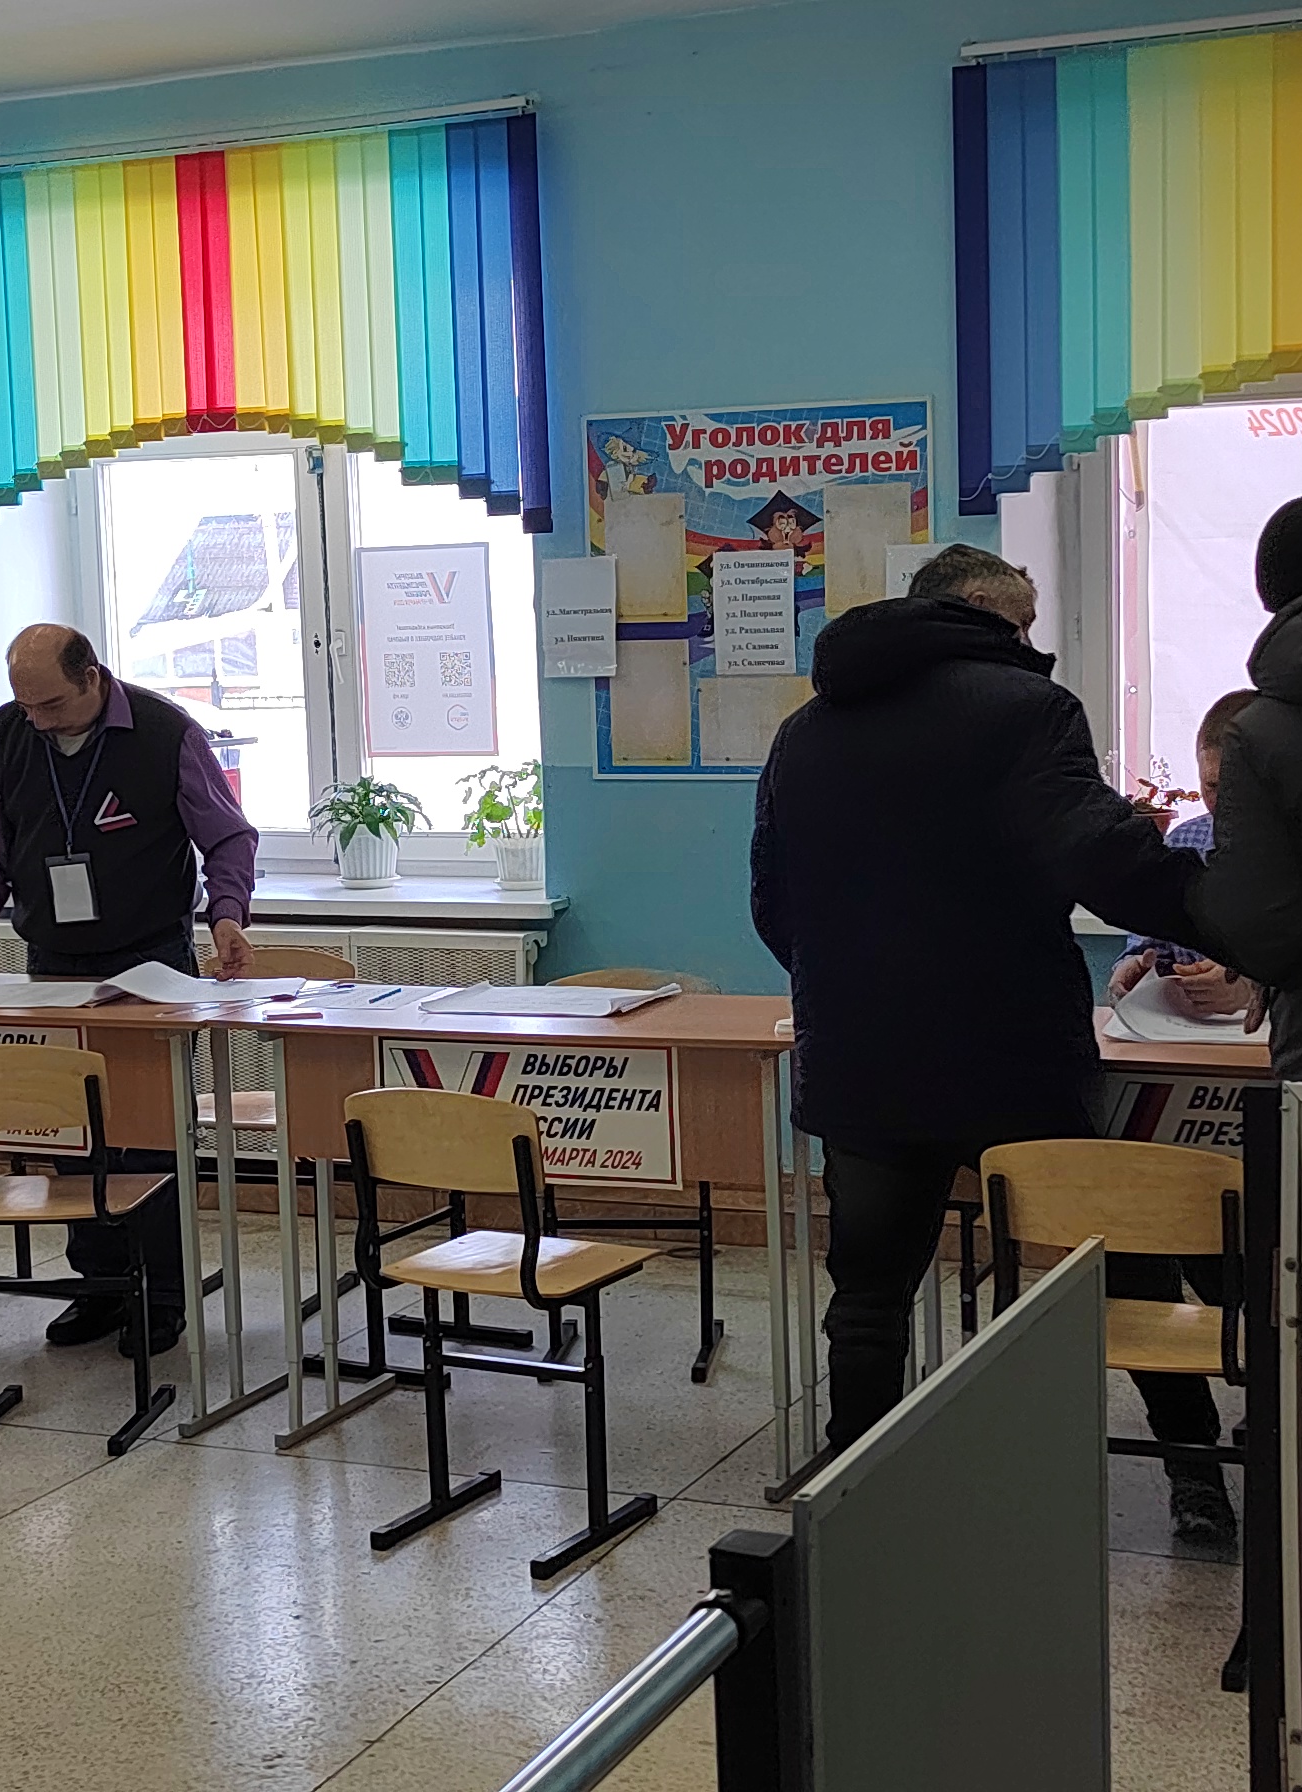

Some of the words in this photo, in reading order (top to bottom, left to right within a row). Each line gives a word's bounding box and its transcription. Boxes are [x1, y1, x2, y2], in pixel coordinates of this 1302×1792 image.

[664, 422, 808, 450] Уголок
[816, 418, 892, 448] для
[704, 441, 918, 488] родителей
[720, 579, 733, 587] ул.
[734, 577, 788, 586] Октябрьская
[741, 594, 781, 603] Парковая
[740, 610, 783, 619] Подгорная
[725, 628, 737, 636] ул.
[732, 644, 743, 652] ул.
[741, 659, 785, 667] Солнечная
[521, 1053, 629, 1079] ВЫБОРЫ
[510, 1084, 662, 1113] ПРЕЗИДЕНТА
[537, 1115, 597, 1140] ССИИ
[541, 1147, 596, 1168] МАРТА
[599, 1149, 643, 1171] 2024
